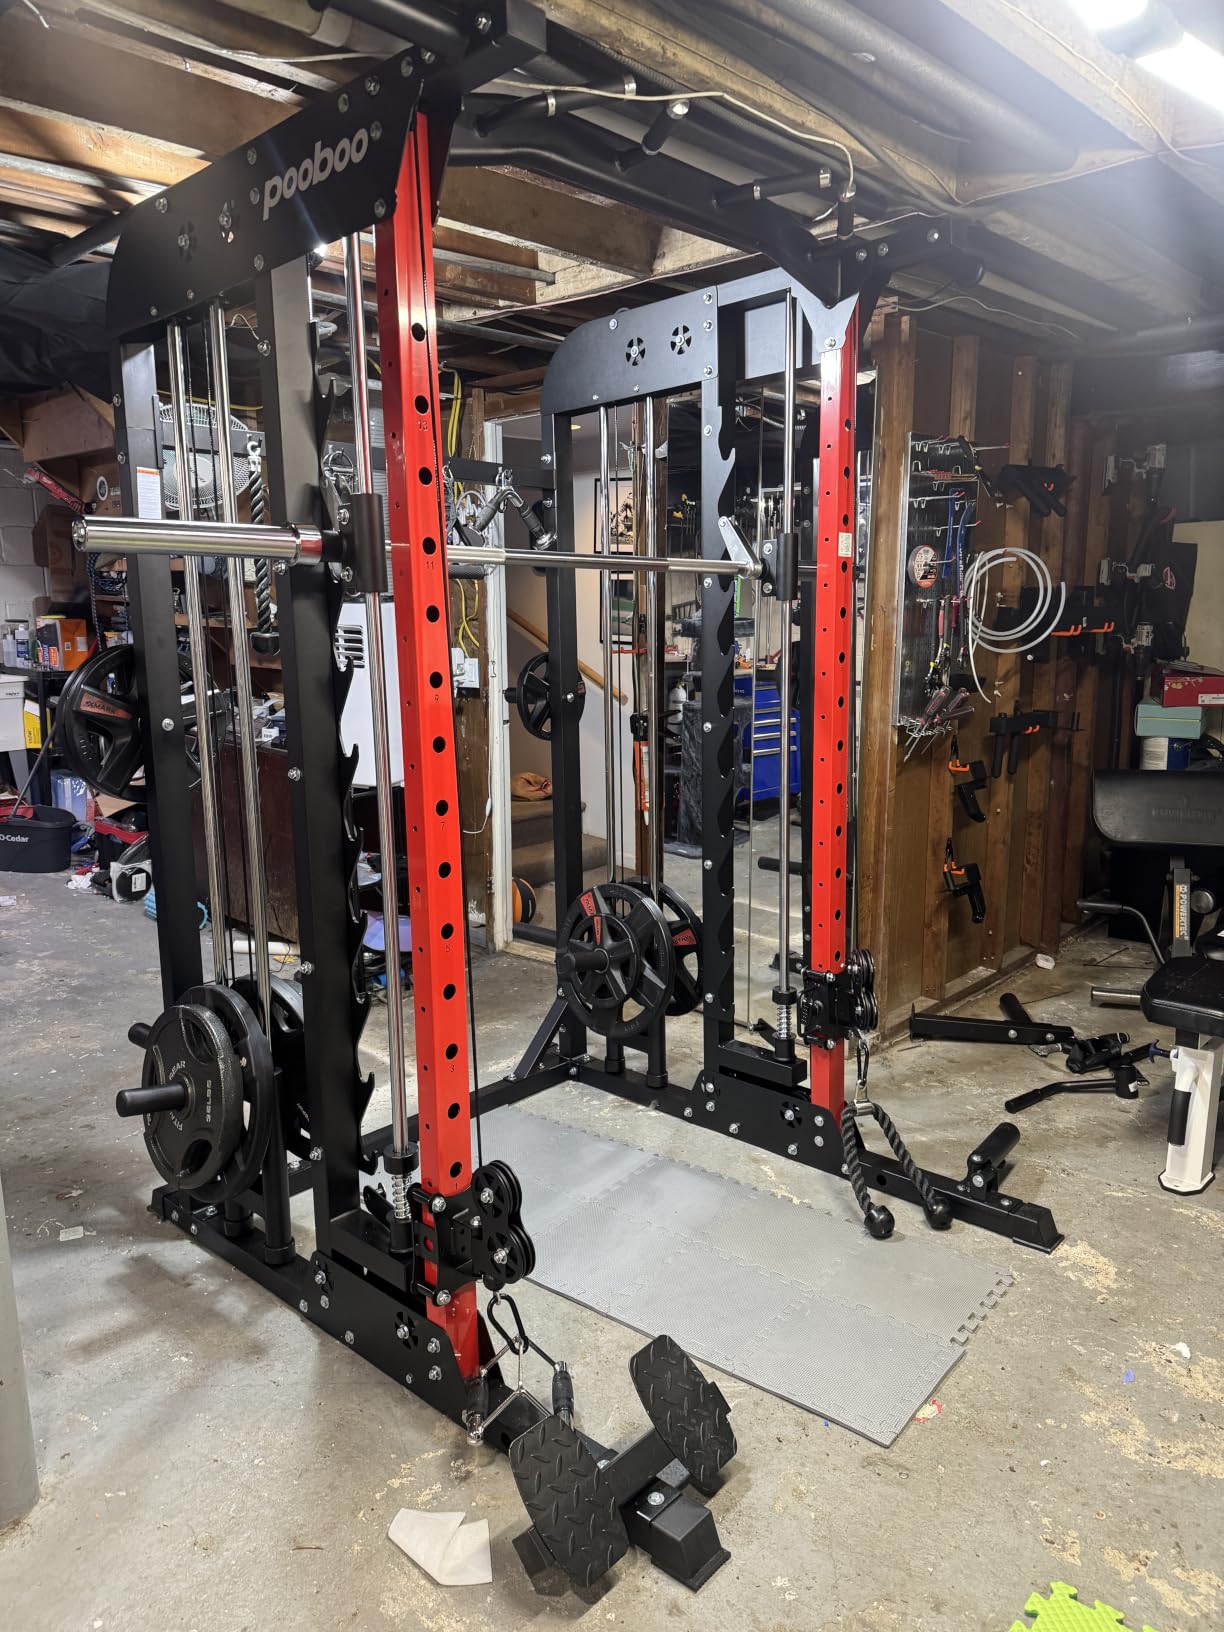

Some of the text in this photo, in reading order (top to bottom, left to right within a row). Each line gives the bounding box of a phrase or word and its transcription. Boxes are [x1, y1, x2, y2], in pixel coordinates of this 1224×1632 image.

[263, 128, 369, 221] pooboo
[417, 420, 428, 430] 13
[426, 560, 434, 570] 11
[1180, 894, 1188, 936] POWERTEC
